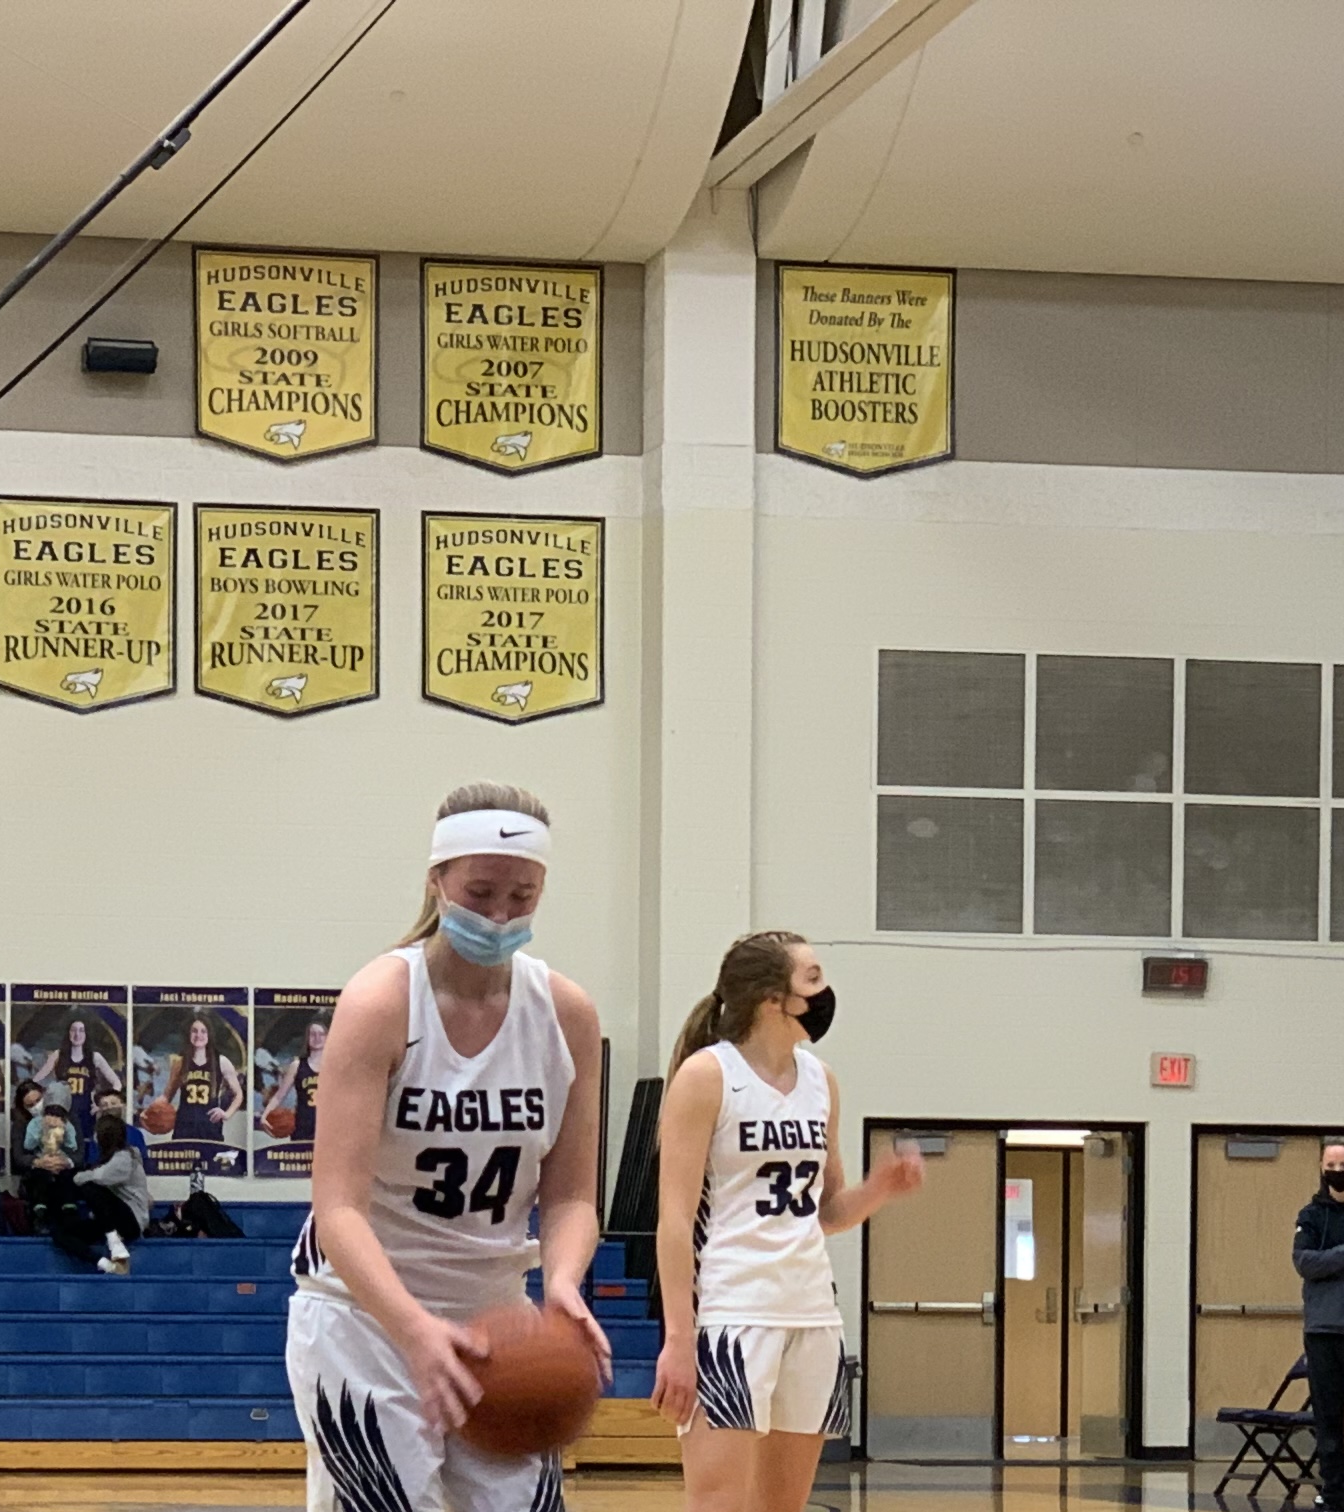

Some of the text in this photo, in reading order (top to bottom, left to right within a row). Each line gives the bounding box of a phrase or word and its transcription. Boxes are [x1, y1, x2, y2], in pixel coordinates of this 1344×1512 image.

[207, 265, 366, 292] HUDSONVILLE
[434, 278, 590, 305] HUDSONVILLE
[802, 286, 927, 307] These Banners Were
[217, 291, 358, 318] EAGLES
[445, 303, 583, 329] EAGLES
[209, 321, 360, 344] GIRLS SOFTBALL
[809, 311, 912, 332] Donated By The
[437, 333, 588, 353] GIRLS WATER POLO
[790, 341, 940, 367] HUDSONVILLE
[255, 348, 319, 367] 2009
[480, 360, 544, 378] 2007
[239, 371, 332, 388] STATE
[465, 381, 558, 399] STATE
[812, 371, 916, 396] ATHLETIC
[208, 388, 362, 422] CHAMPIONS
[436, 399, 588, 433] CHAMPIONS
[811, 400, 918, 425] BOOSTERS
[3, 514, 163, 542] HUDSONVILLE
[207, 522, 366, 548] HUDSONVILLE
[14, 540, 155, 565] EAGLES
[435, 531, 592, 556] HUDSONVILLE
[218, 548, 358, 572] EAGLES
[446, 556, 583, 580] EAGLES
[4, 570, 161, 591] GIRLS WATER POLO
[210, 577, 360, 597] BOYS BOWLING
[437, 584, 589, 604] GIRLS WATER POLO
[50, 597, 115, 616] 2016
[255, 603, 319, 621] 2017
[35, 620, 130, 636] STATE
[481, 611, 544, 629] 2017
[241, 626, 332, 643] STATE
[467, 633, 558, 650] STATE
[4, 636, 160, 666] RUNNER-UP
[210, 642, 364, 672] RUNNER-UP
[437, 648, 588, 681] CHAMPIONS
[1160, 1057, 1191, 1082] EXIT
[187, 1085, 209, 1104] 33
[395, 1087, 545, 1132] EAGLES
[740, 1120, 827, 1151] EAGLES
[412, 1146, 521, 1226] 34
